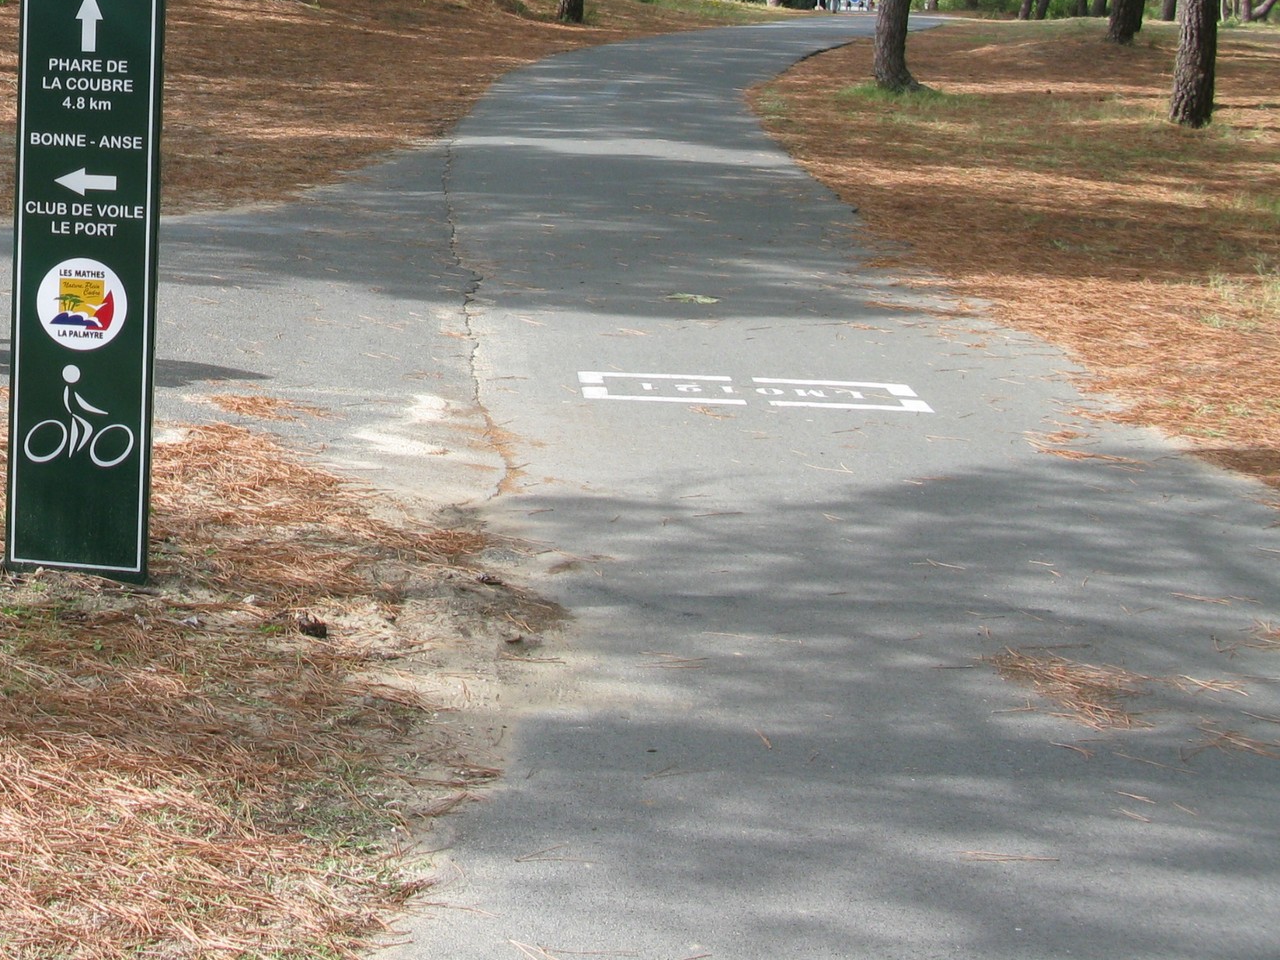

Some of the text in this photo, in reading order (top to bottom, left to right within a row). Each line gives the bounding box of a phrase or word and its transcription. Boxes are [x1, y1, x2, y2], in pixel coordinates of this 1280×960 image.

[49, 58, 127, 73] PHARE DE
[43, 77, 133, 92] LA COUBRE
[62, 97, 111, 110] 4.8 km
[31, 133, 86, 146] BONNE
[99, 136, 142, 149] ANSE
[26, 201, 143, 218] CLUB DE VOILE
[52, 221, 117, 236] LE PORT
[75, 270, 105, 278] MATHES
[69, 330, 104, 339] PALMYRE
